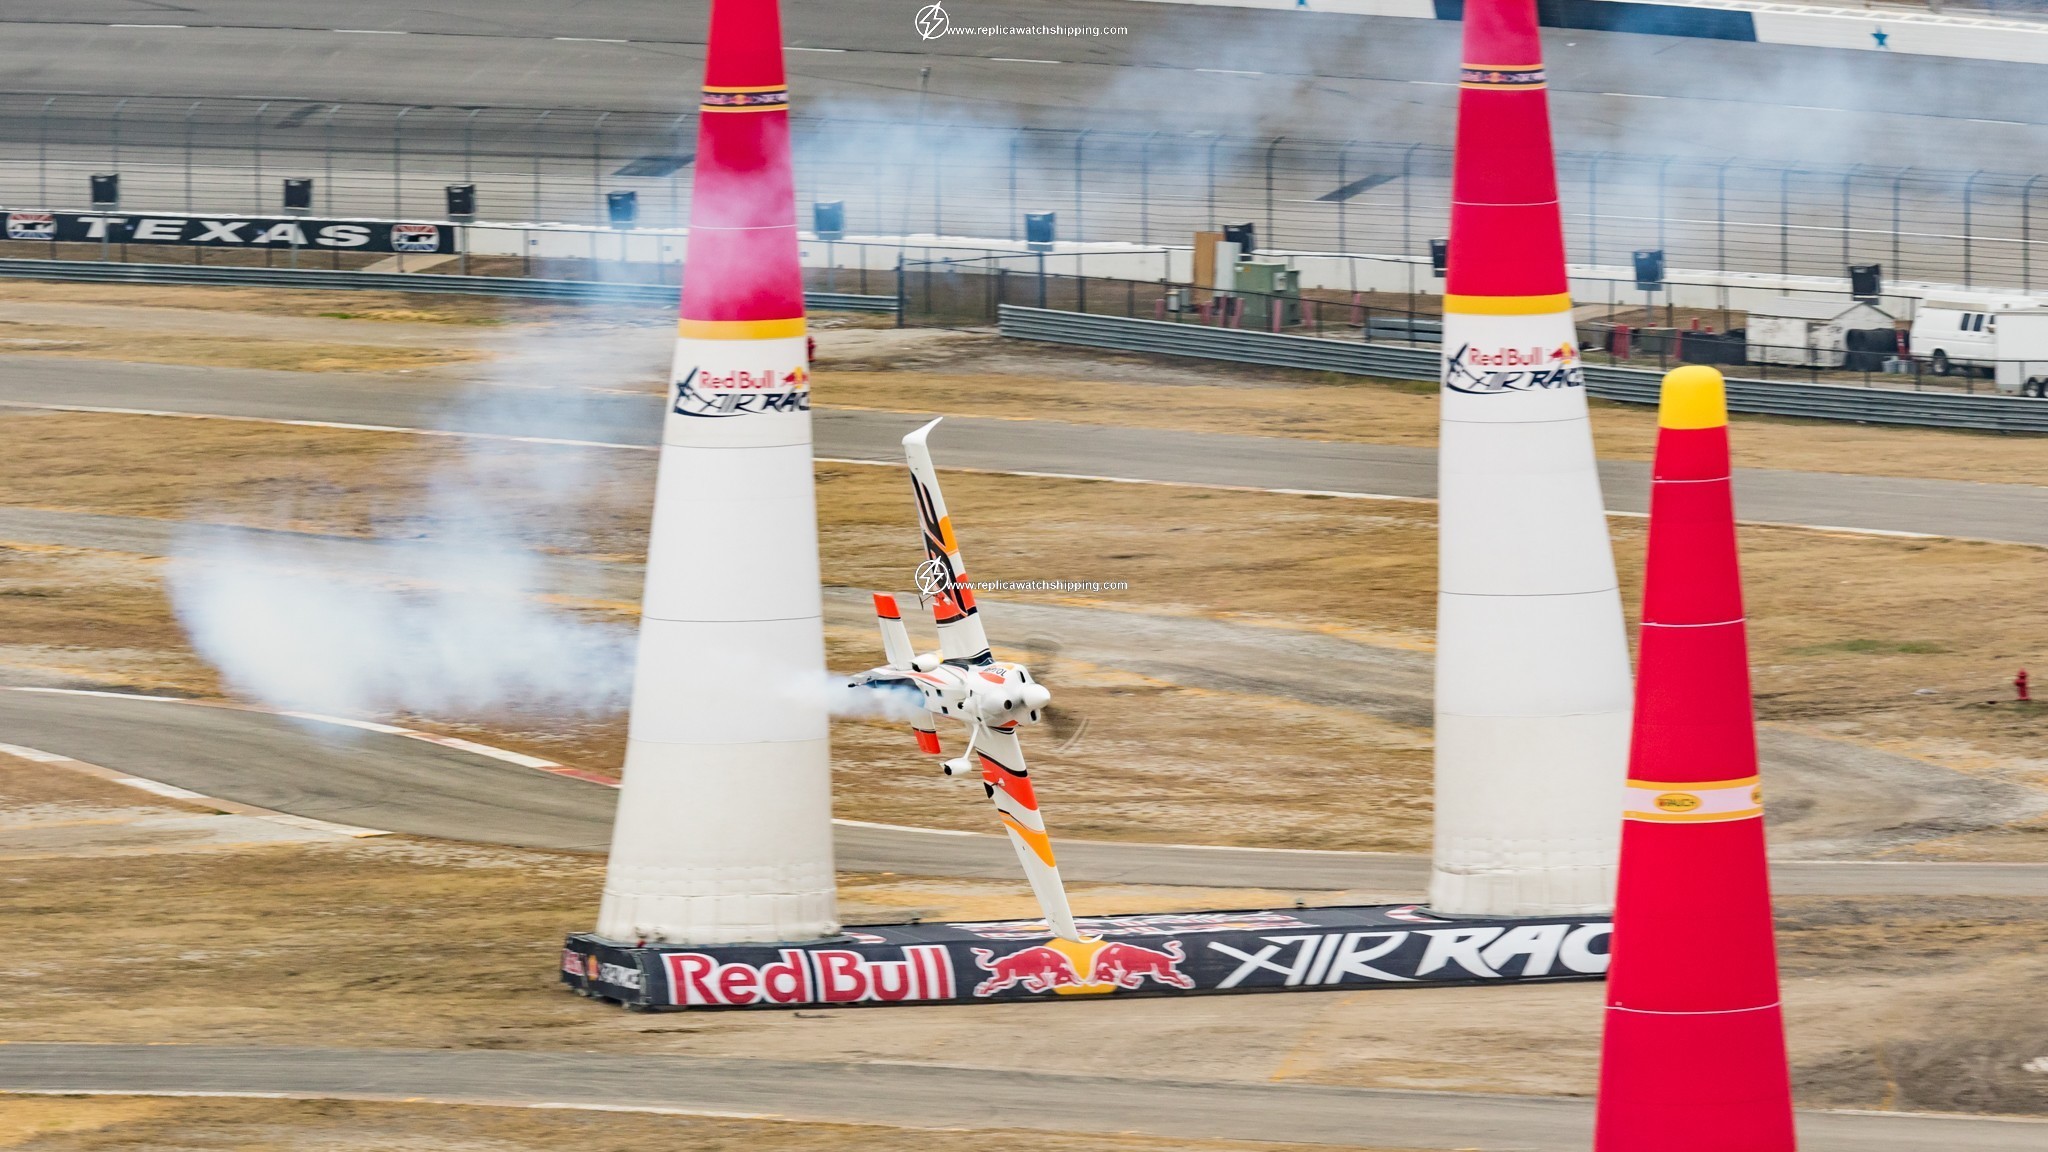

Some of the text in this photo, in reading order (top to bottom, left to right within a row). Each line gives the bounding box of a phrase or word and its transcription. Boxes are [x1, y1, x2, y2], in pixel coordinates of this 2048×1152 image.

[76, 217, 372, 247] TEXAS
[1469, 347, 1543, 366] Red Bull
[699, 369, 775, 389] Red Bull
[1527, 368, 1584, 389] RAC
[1207, 922, 1615, 989] AIR RAC
[661, 949, 813, 1005] Red
[809, 945, 956, 1002] Bull
